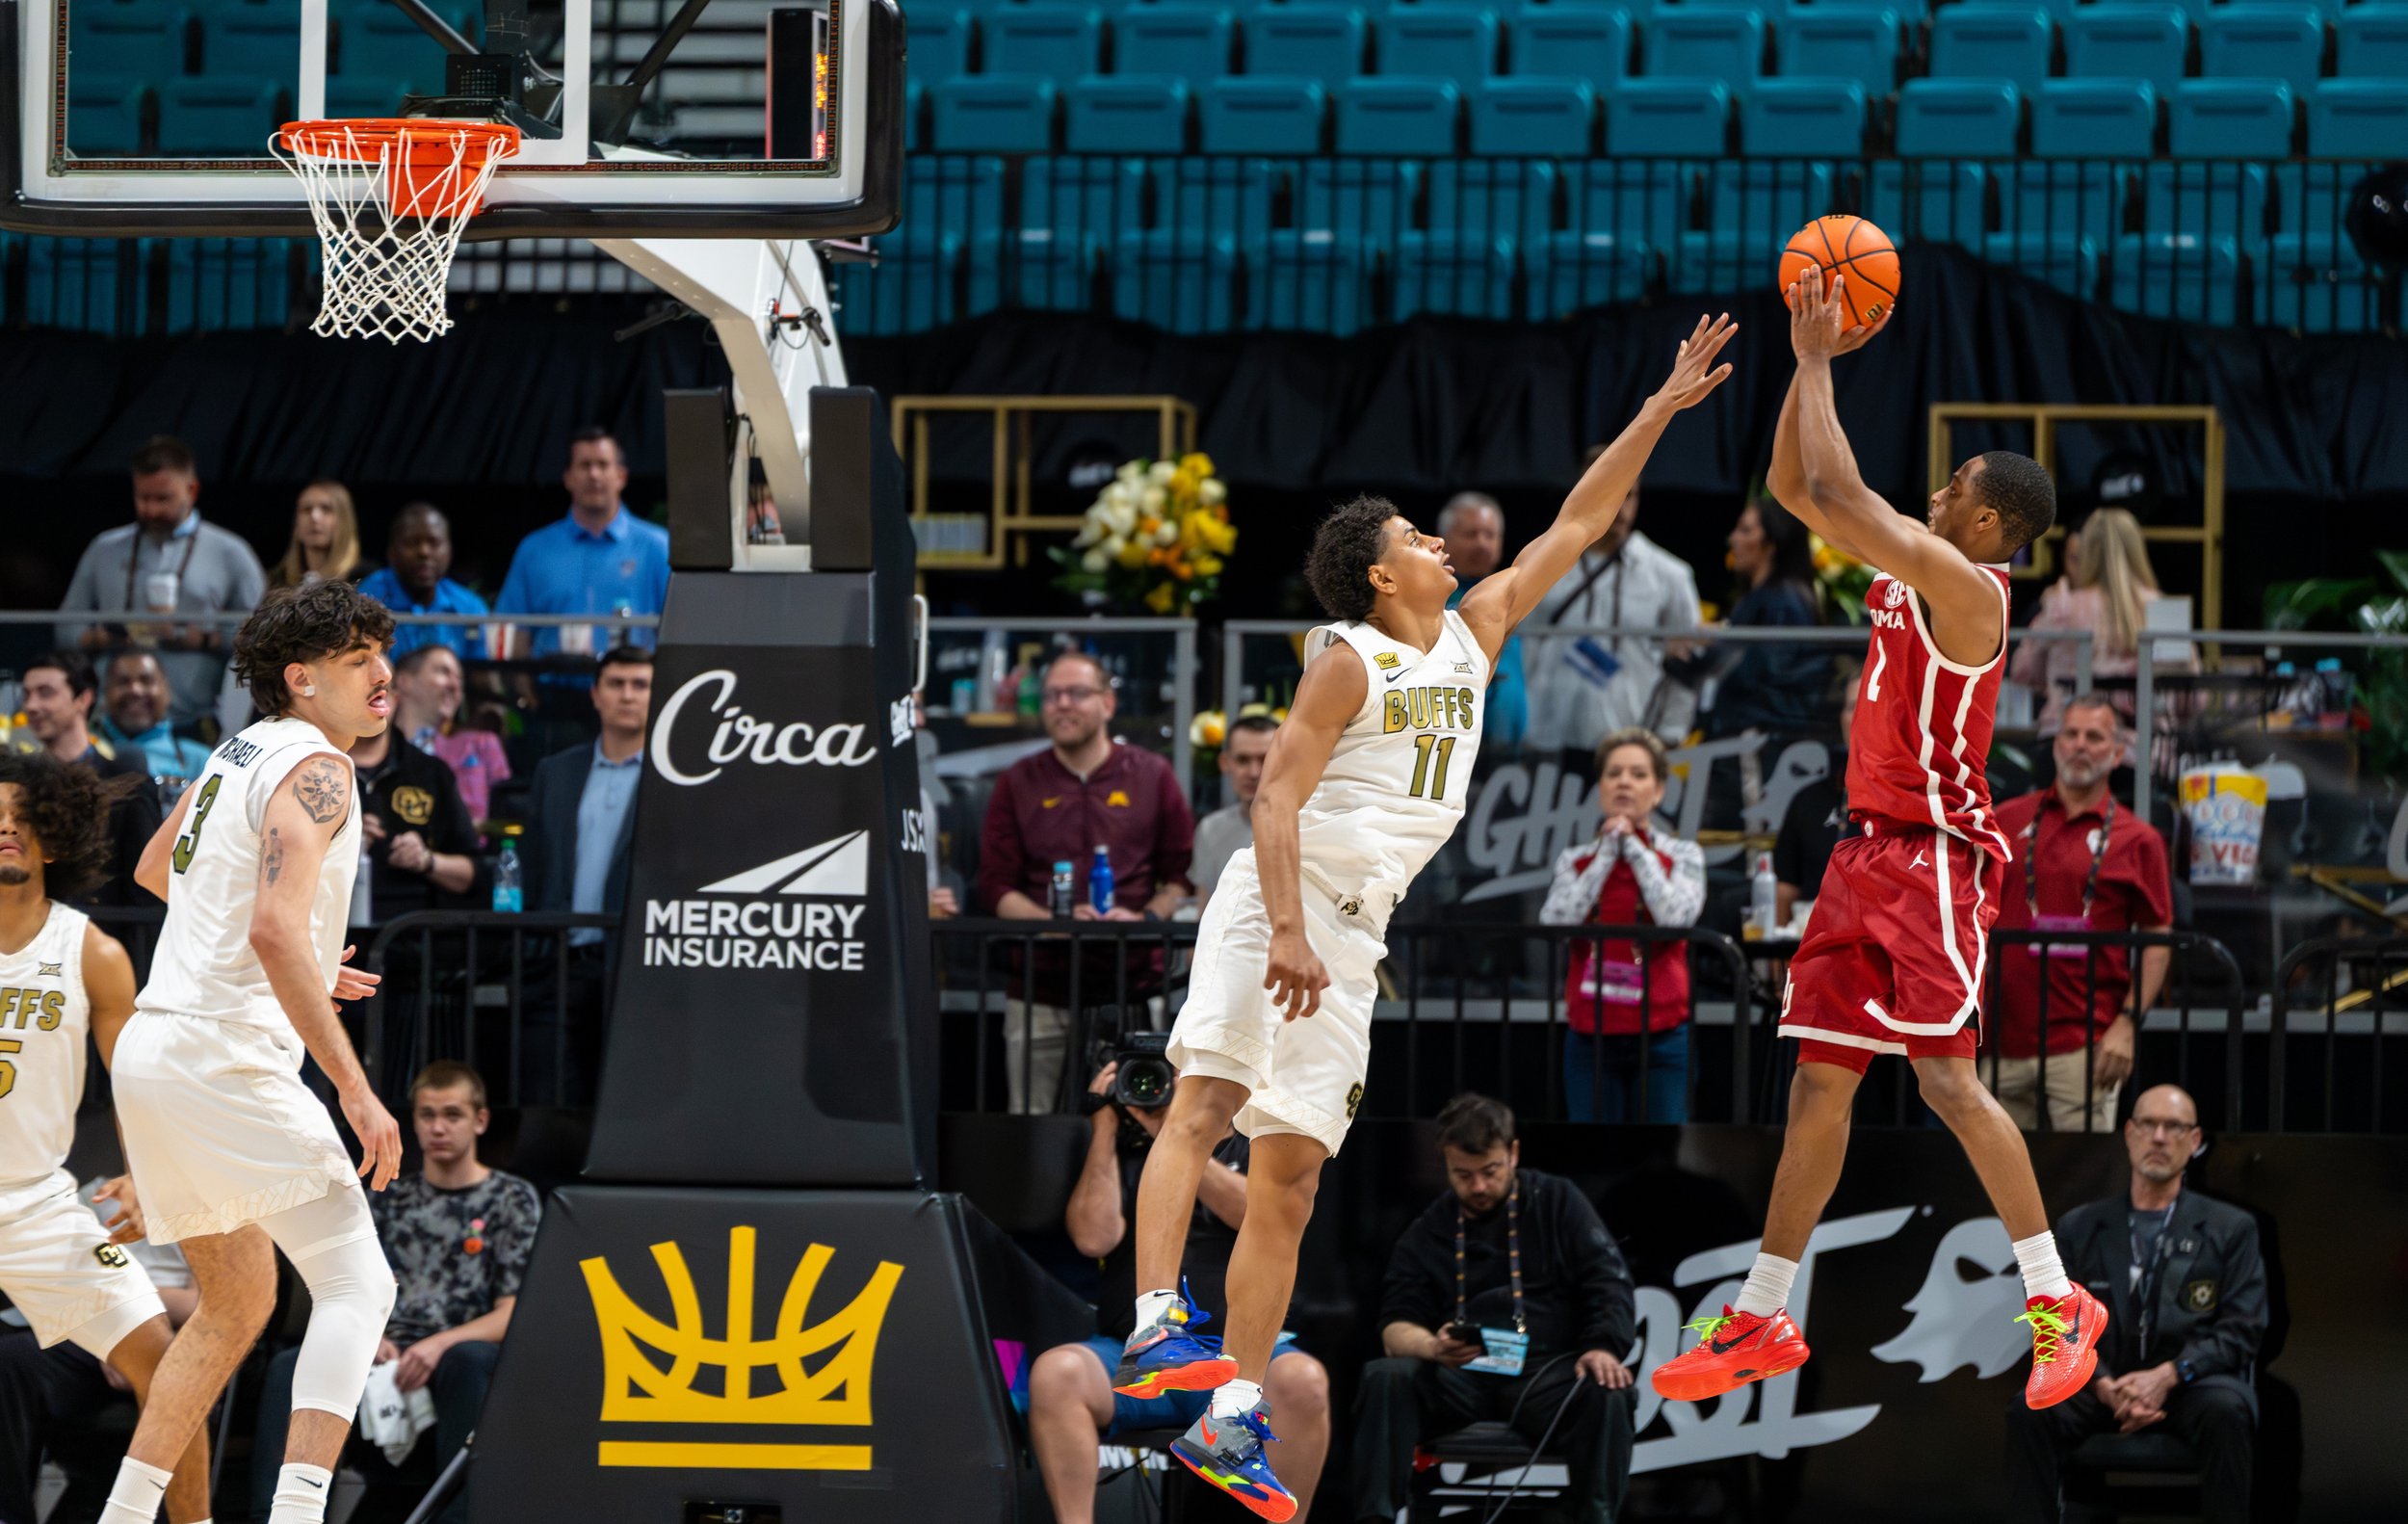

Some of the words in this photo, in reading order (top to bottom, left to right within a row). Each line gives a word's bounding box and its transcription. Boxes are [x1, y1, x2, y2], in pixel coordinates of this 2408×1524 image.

[650, 670, 877, 786] Circa
[1383, 686, 1474, 734] BUFFS
[1408, 733, 1456, 801] 11
[172, 773, 223, 875] 3
[644, 900, 866, 938] MERCURY
[643, 937, 865, 970] INSURANCE
